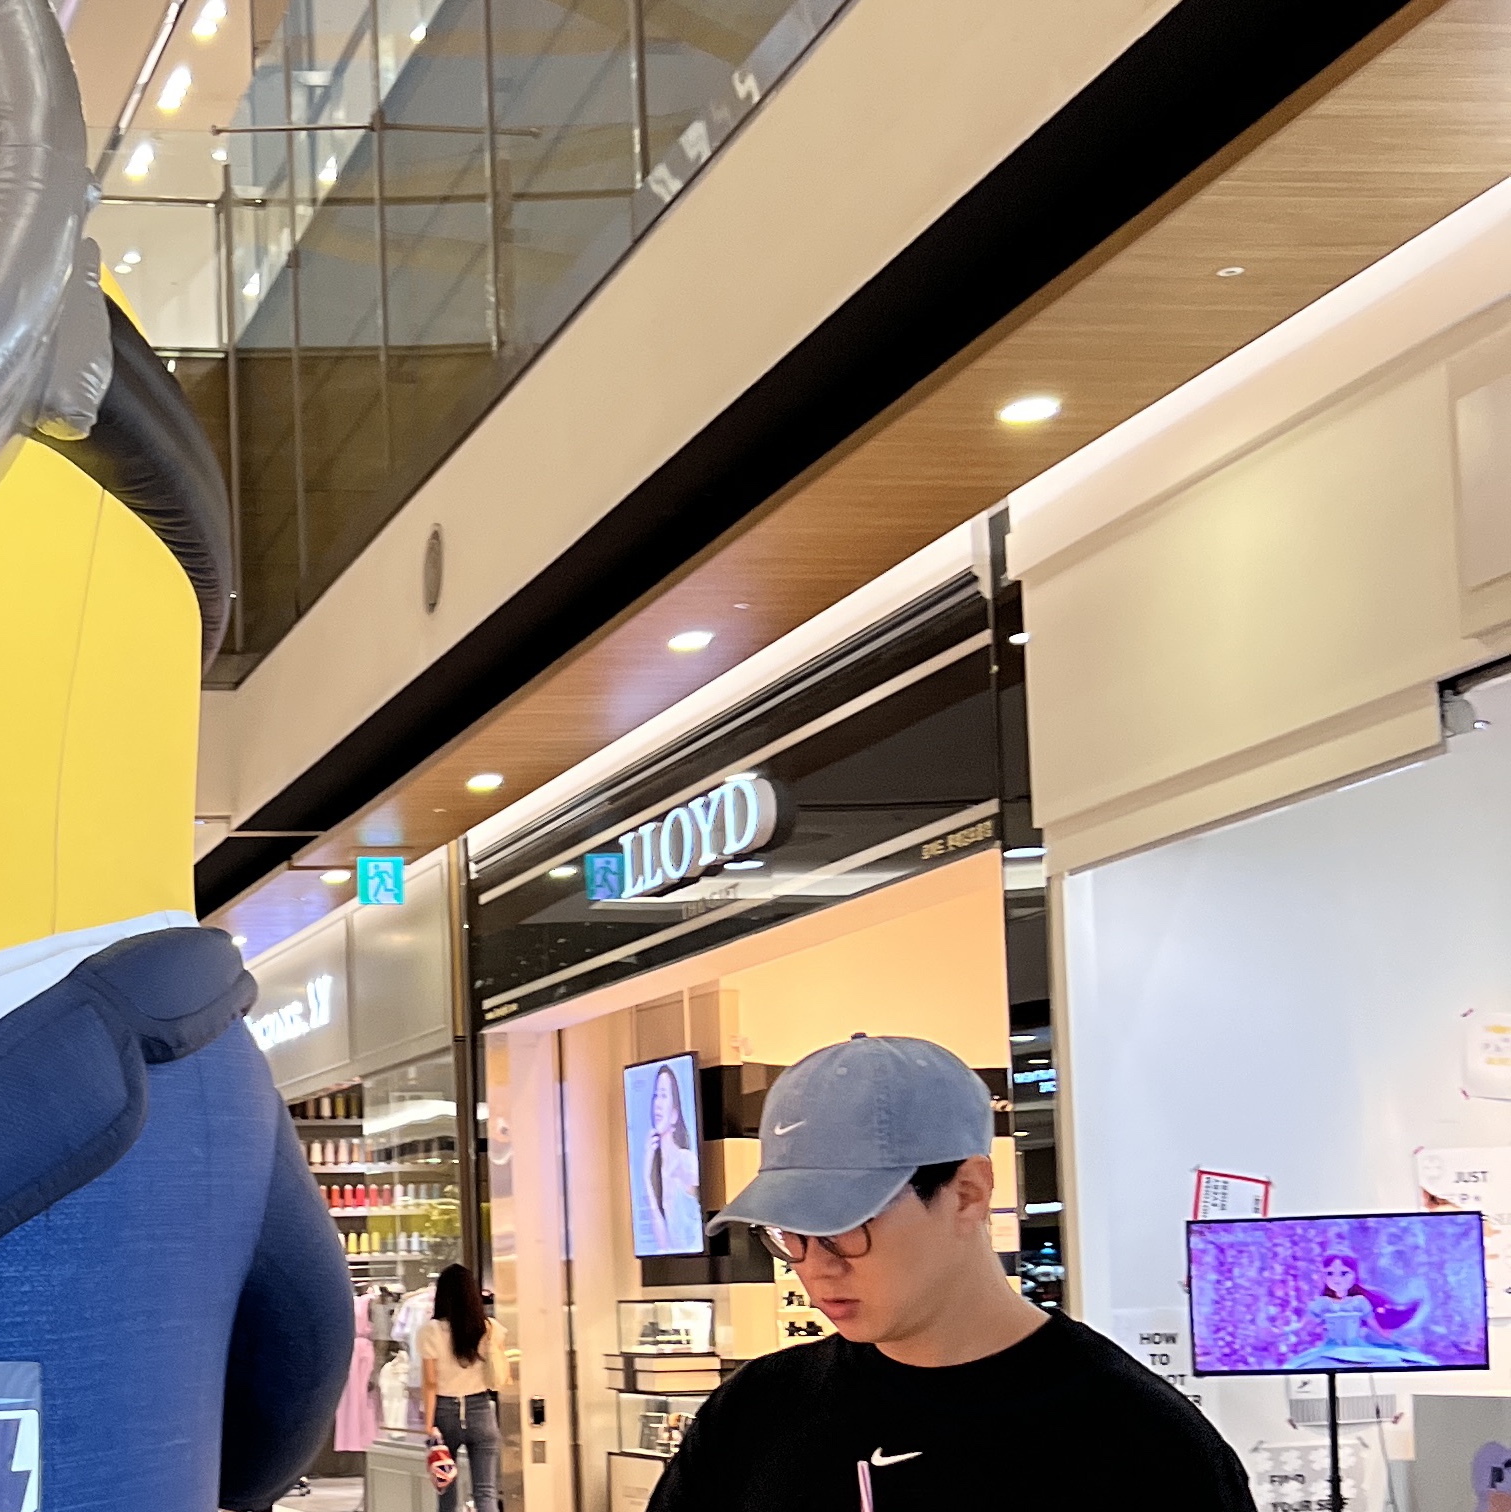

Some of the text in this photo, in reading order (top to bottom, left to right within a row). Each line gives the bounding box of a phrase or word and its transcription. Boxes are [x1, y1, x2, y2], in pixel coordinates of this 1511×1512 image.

[619, 779, 760, 899] LLOYD
[1139, 1332, 1178, 1345] HOW
[1148, 1353, 1170, 1366] TO
[1159, 1374, 1186, 1387] OT
[1271, 1499, 1312, 1512] YOUR
